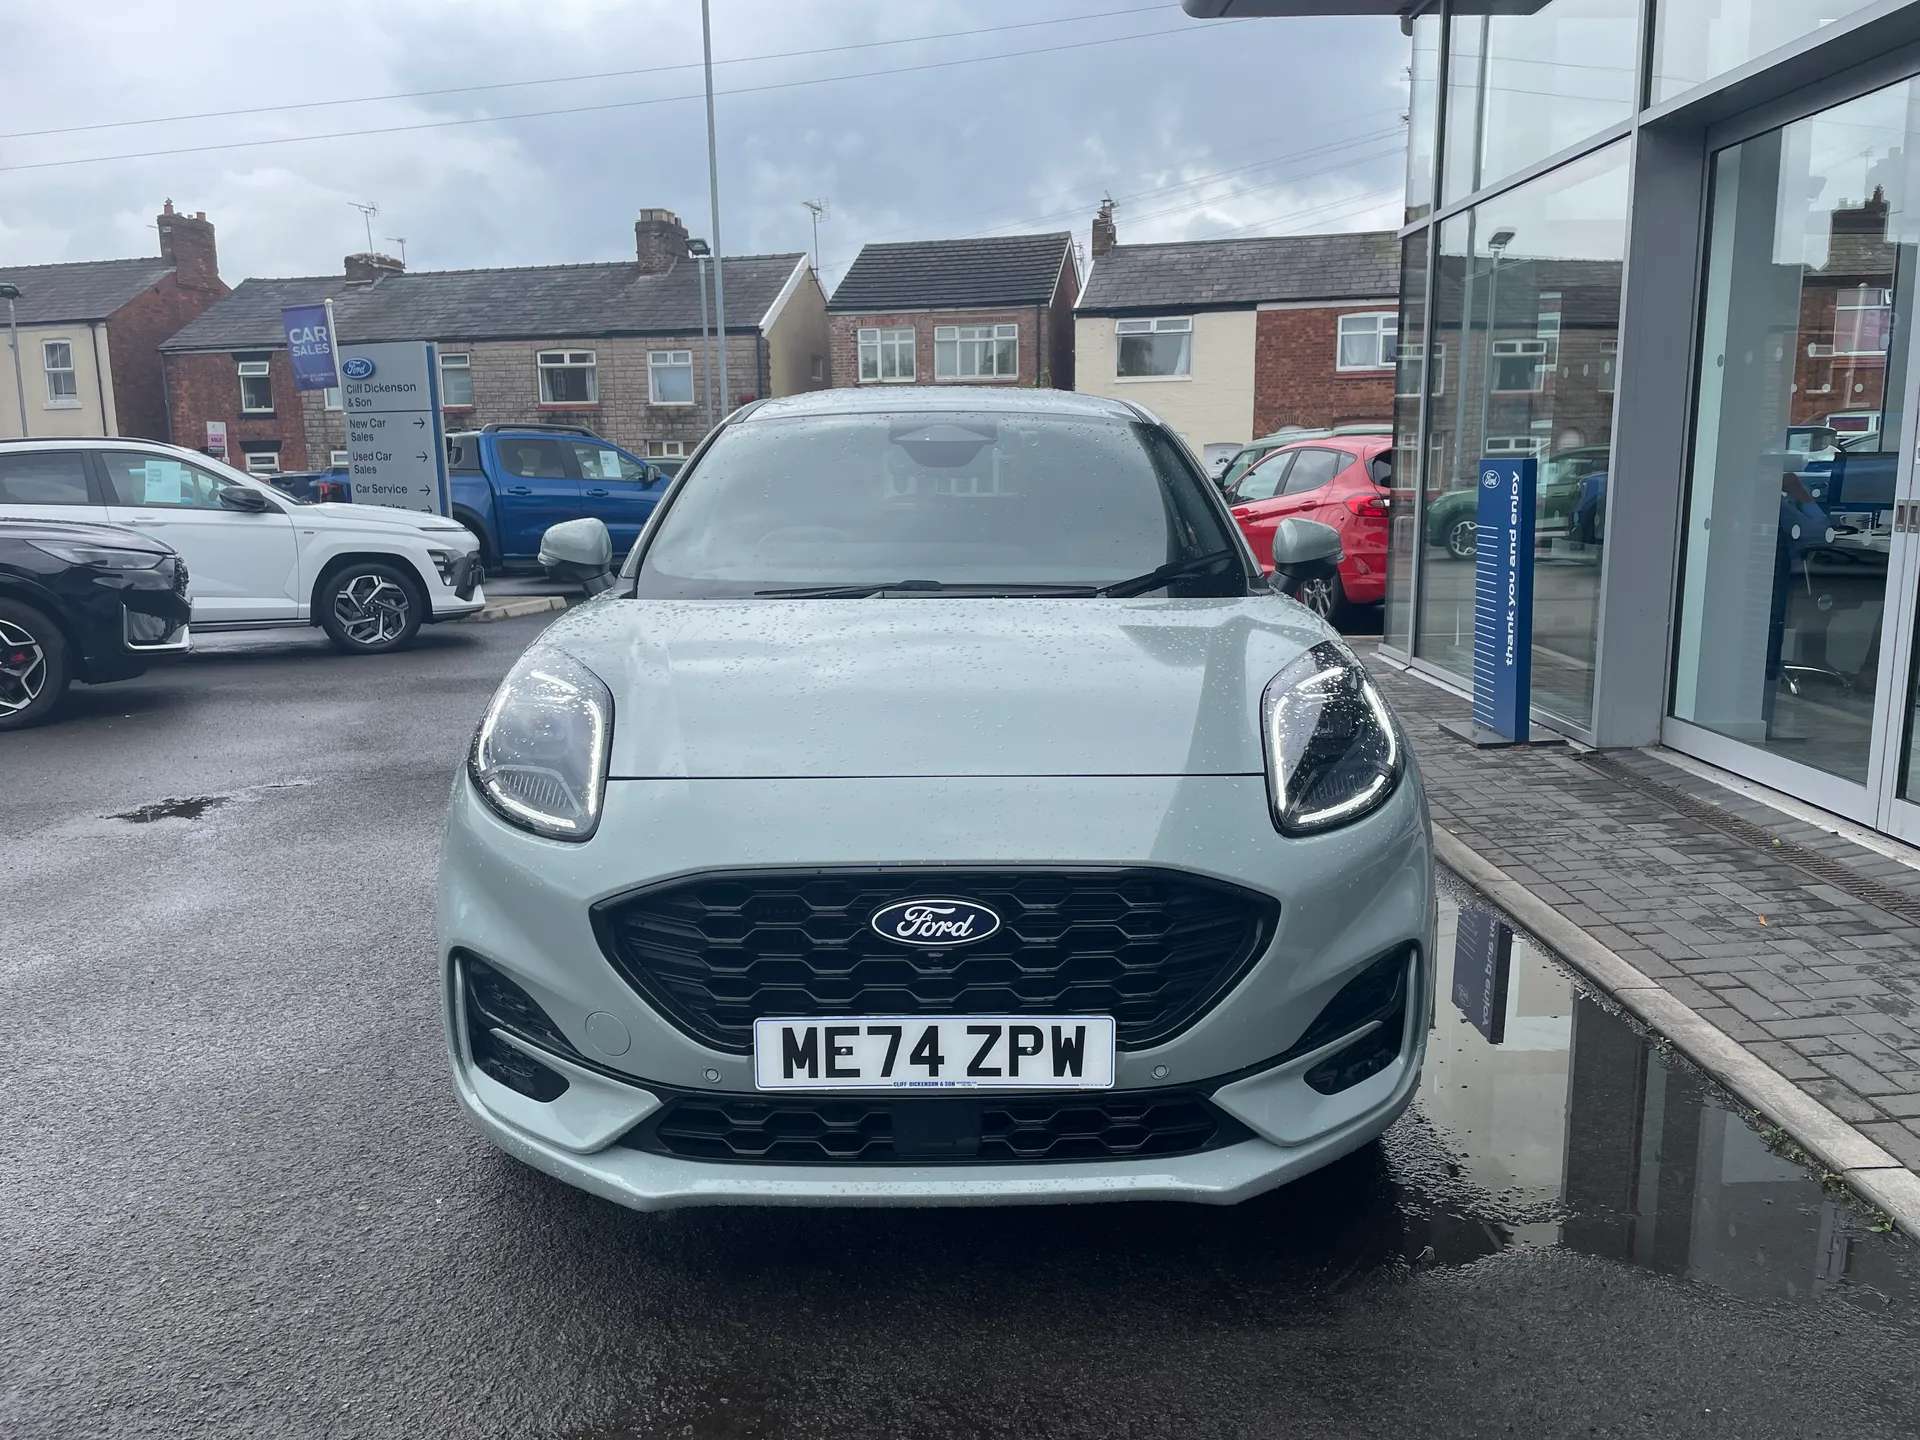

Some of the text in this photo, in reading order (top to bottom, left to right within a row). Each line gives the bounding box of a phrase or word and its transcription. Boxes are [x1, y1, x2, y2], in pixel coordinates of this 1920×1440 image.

[289, 326, 328, 345] CAR
[292, 343, 330, 357] SALES
[346, 359, 368, 375] Ford
[346, 383, 417, 394] Cliff Dickenson
[347, 397, 372, 408] & Son
[349, 418, 386, 429] New Car
[351, 432, 374, 442] Sales
[352, 451, 393, 461] Used Car
[354, 464, 377, 475] Sales
[355, 483, 408, 494] Car Service
[1506, 471, 1520, 666] thank you and enjoy
[895, 905, 976, 938] Ford
[781, 1025, 1086, 1079] ME74 ZPW
